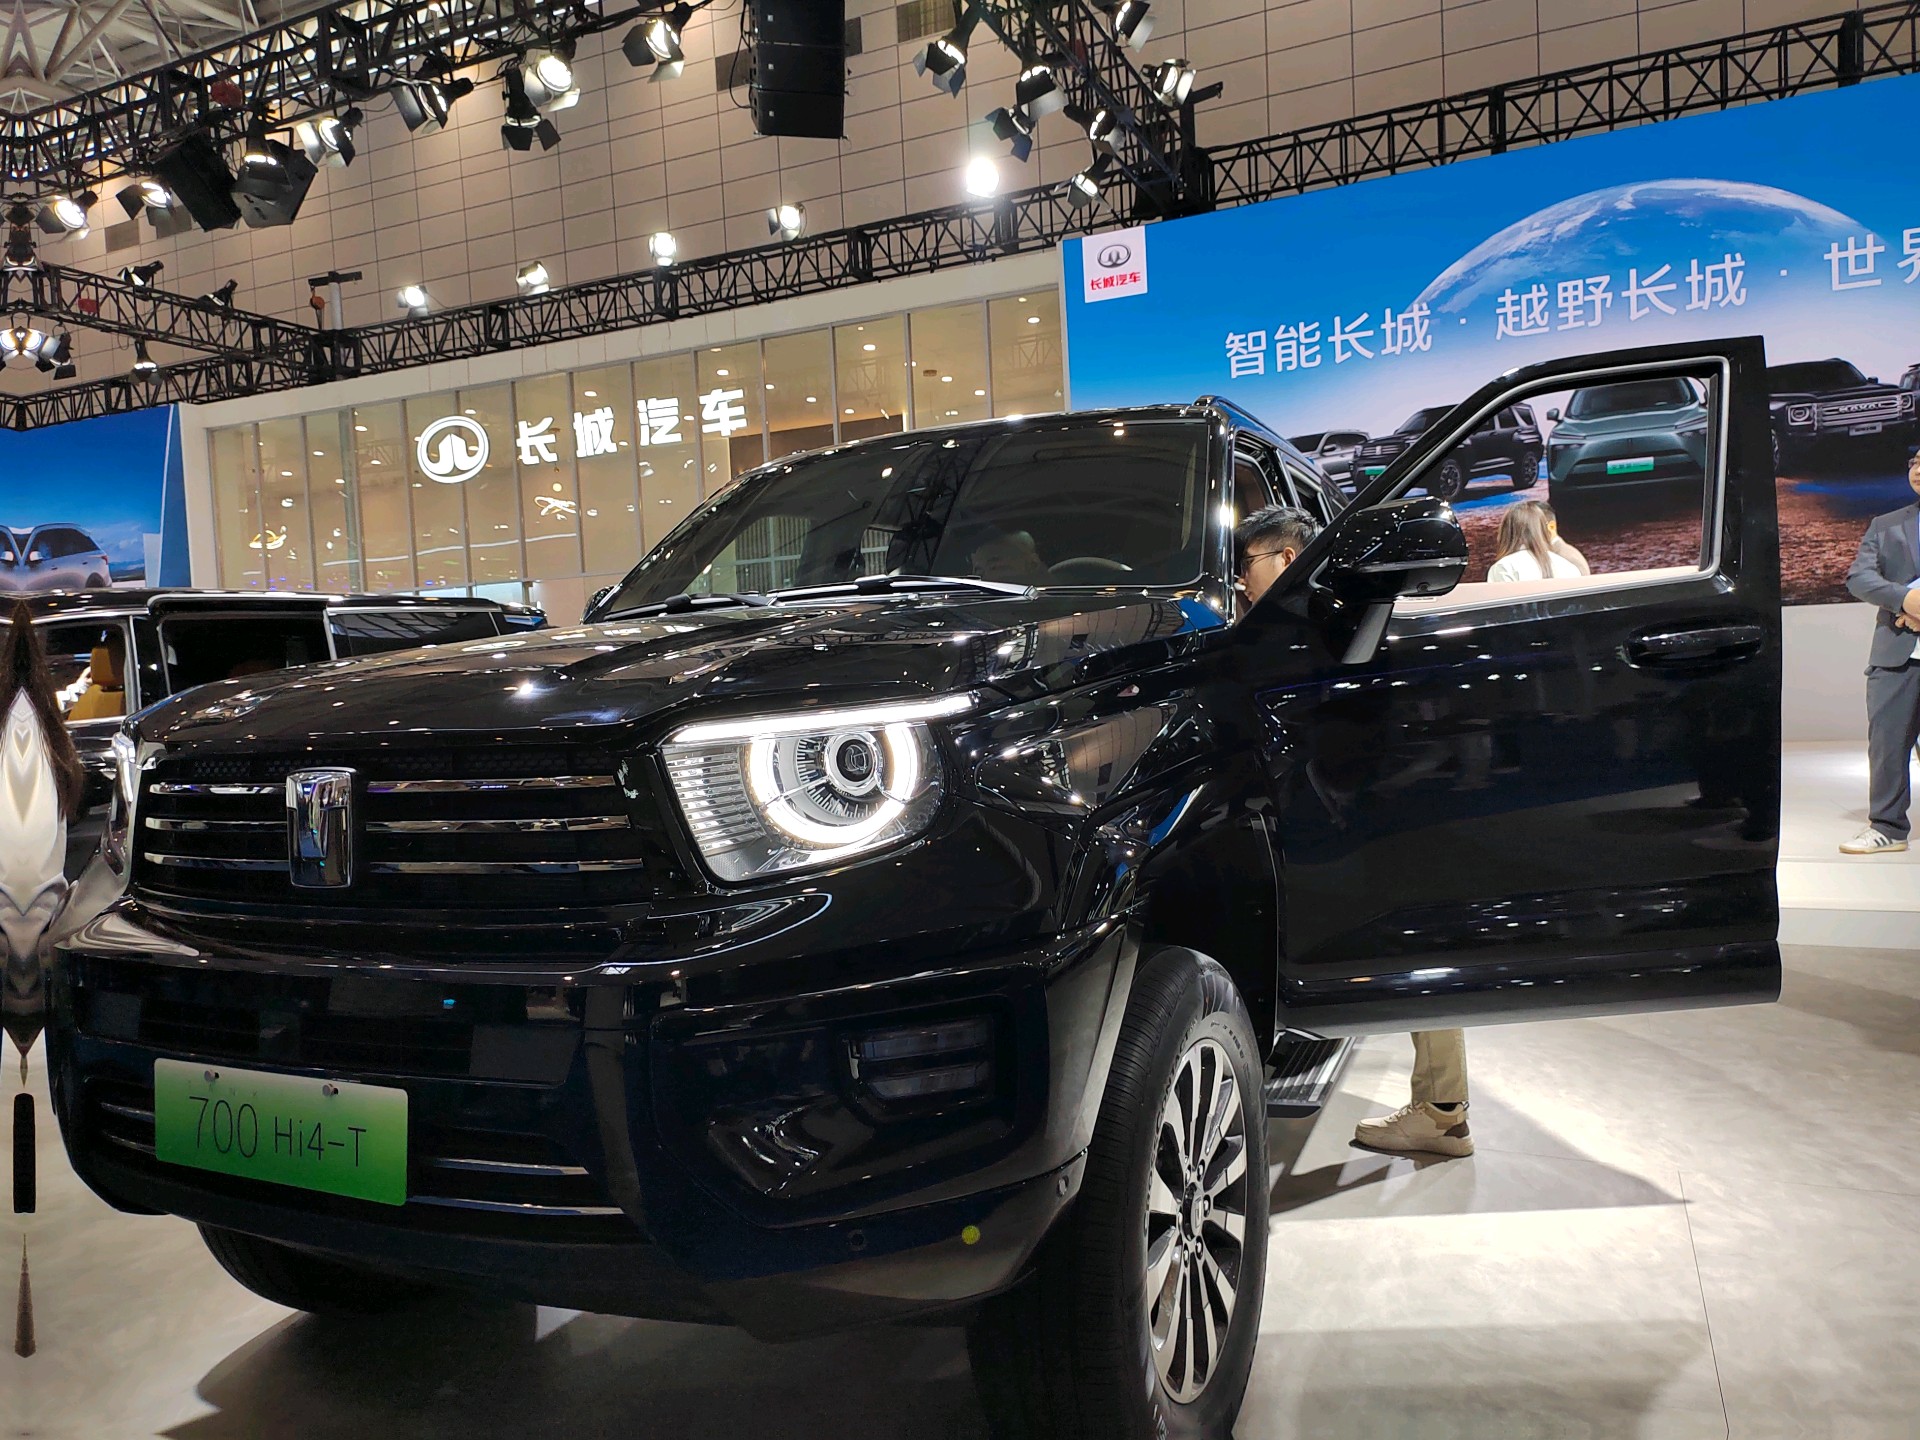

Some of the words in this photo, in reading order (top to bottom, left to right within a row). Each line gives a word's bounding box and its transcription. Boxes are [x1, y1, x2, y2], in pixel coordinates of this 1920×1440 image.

[1090, 272, 1141, 290] 长城汽车
[1225, 302, 1432, 378] 智能长城
[1495, 252, 1747, 340] 越野长城
[516, 388, 748, 465] 长城汽车
[189, 1096, 258, 1159] 700
[274, 1115, 367, 1168] Hi4-T
